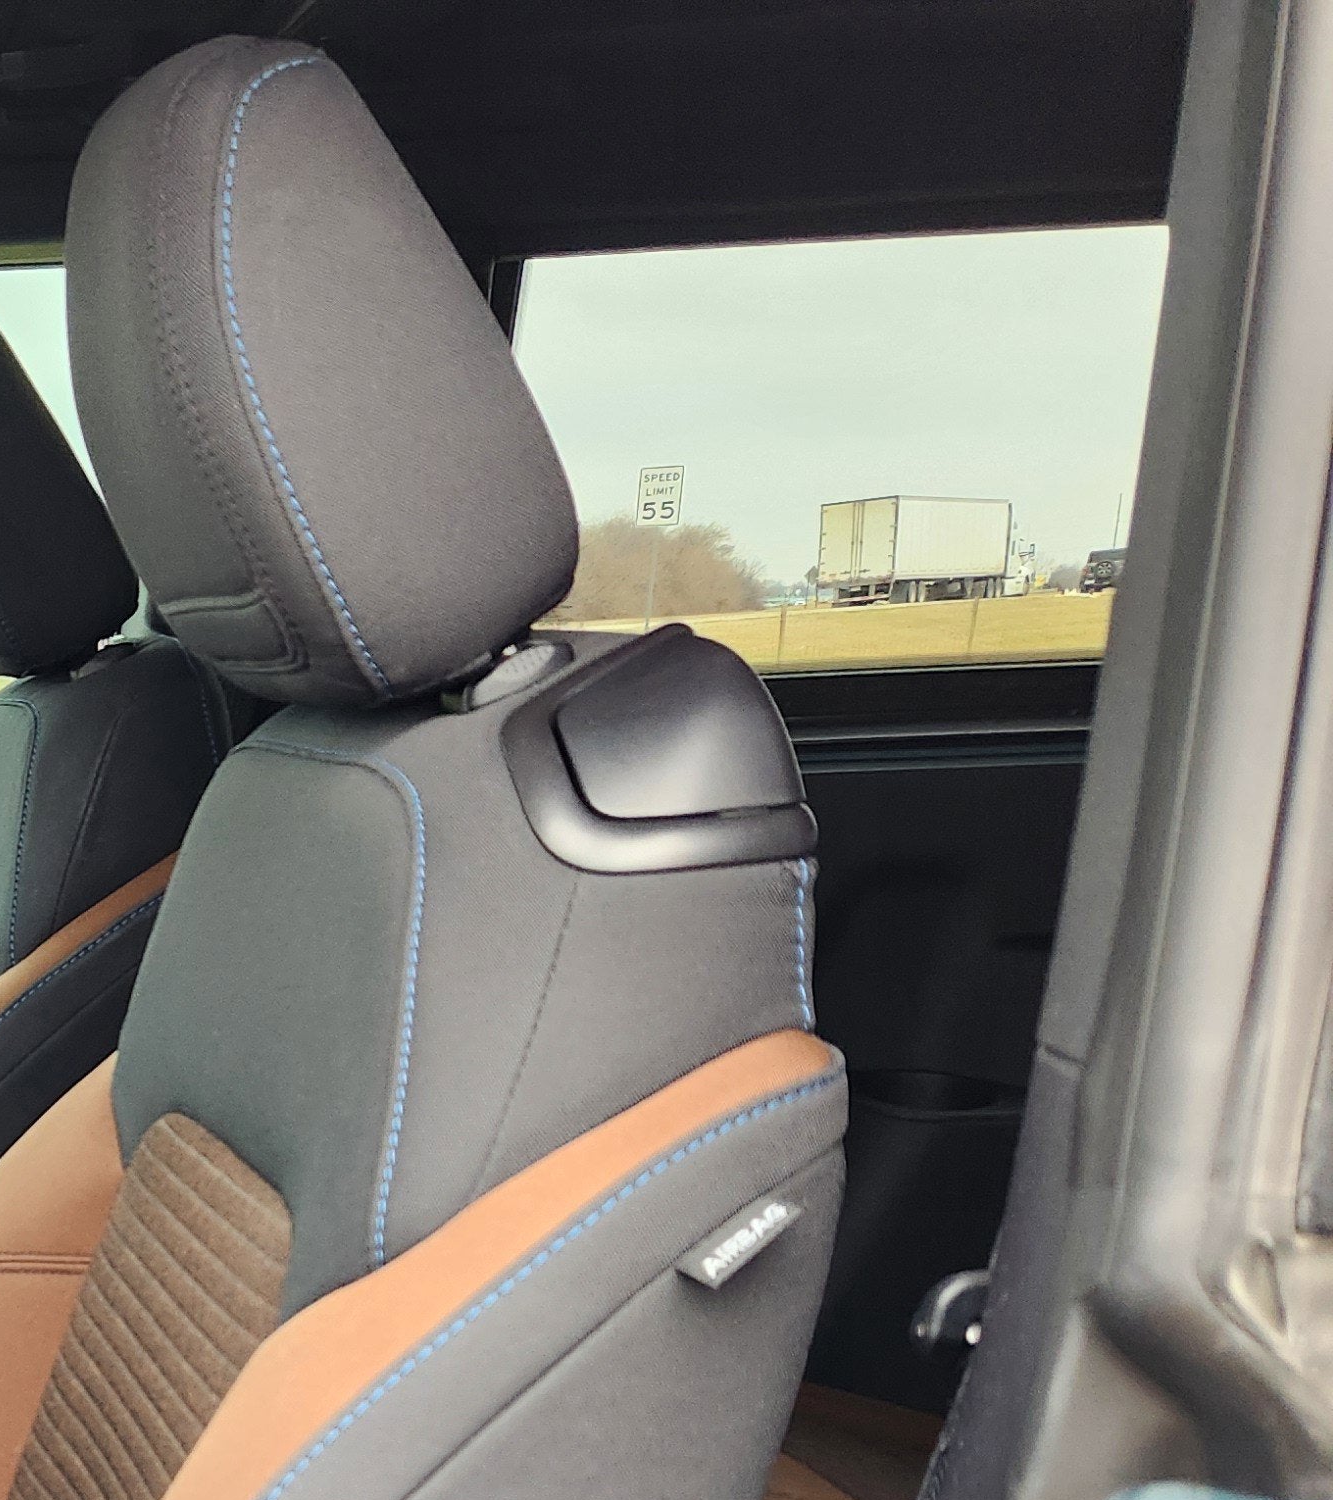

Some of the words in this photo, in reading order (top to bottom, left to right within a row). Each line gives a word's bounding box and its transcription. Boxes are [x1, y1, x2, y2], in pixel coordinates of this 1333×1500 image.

[643, 472, 681, 483] SPEED
[645, 486, 675, 497] LIMIT
[641, 500, 675, 520] 55
